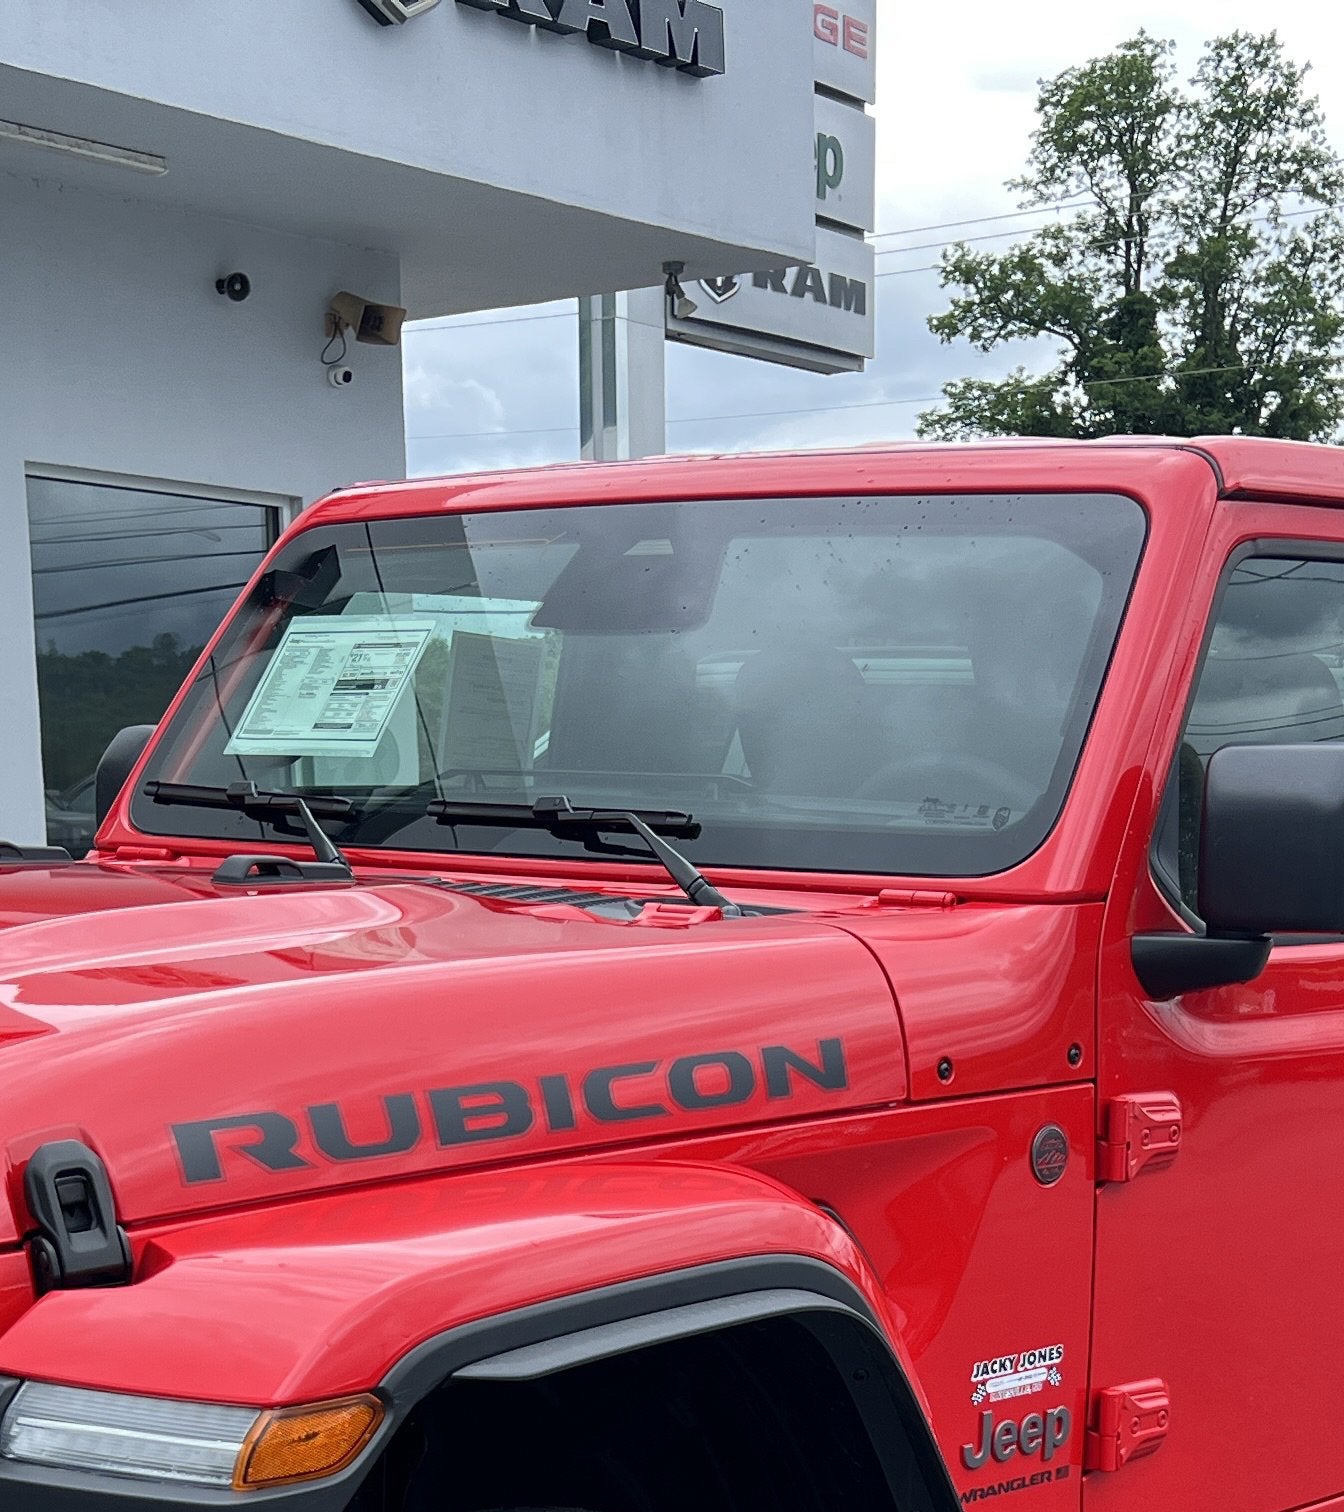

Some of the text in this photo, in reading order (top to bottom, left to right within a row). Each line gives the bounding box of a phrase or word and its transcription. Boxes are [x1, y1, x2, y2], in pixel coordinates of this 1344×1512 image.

[456, 0, 725, 78] AM
[167, 1037, 849, 1188] RUBICON
[972, 1345, 1063, 1379] JACKY JONES
[961, 1405, 1072, 1470] Jeep
[960, 1469, 1053, 1504] WRANGLER
